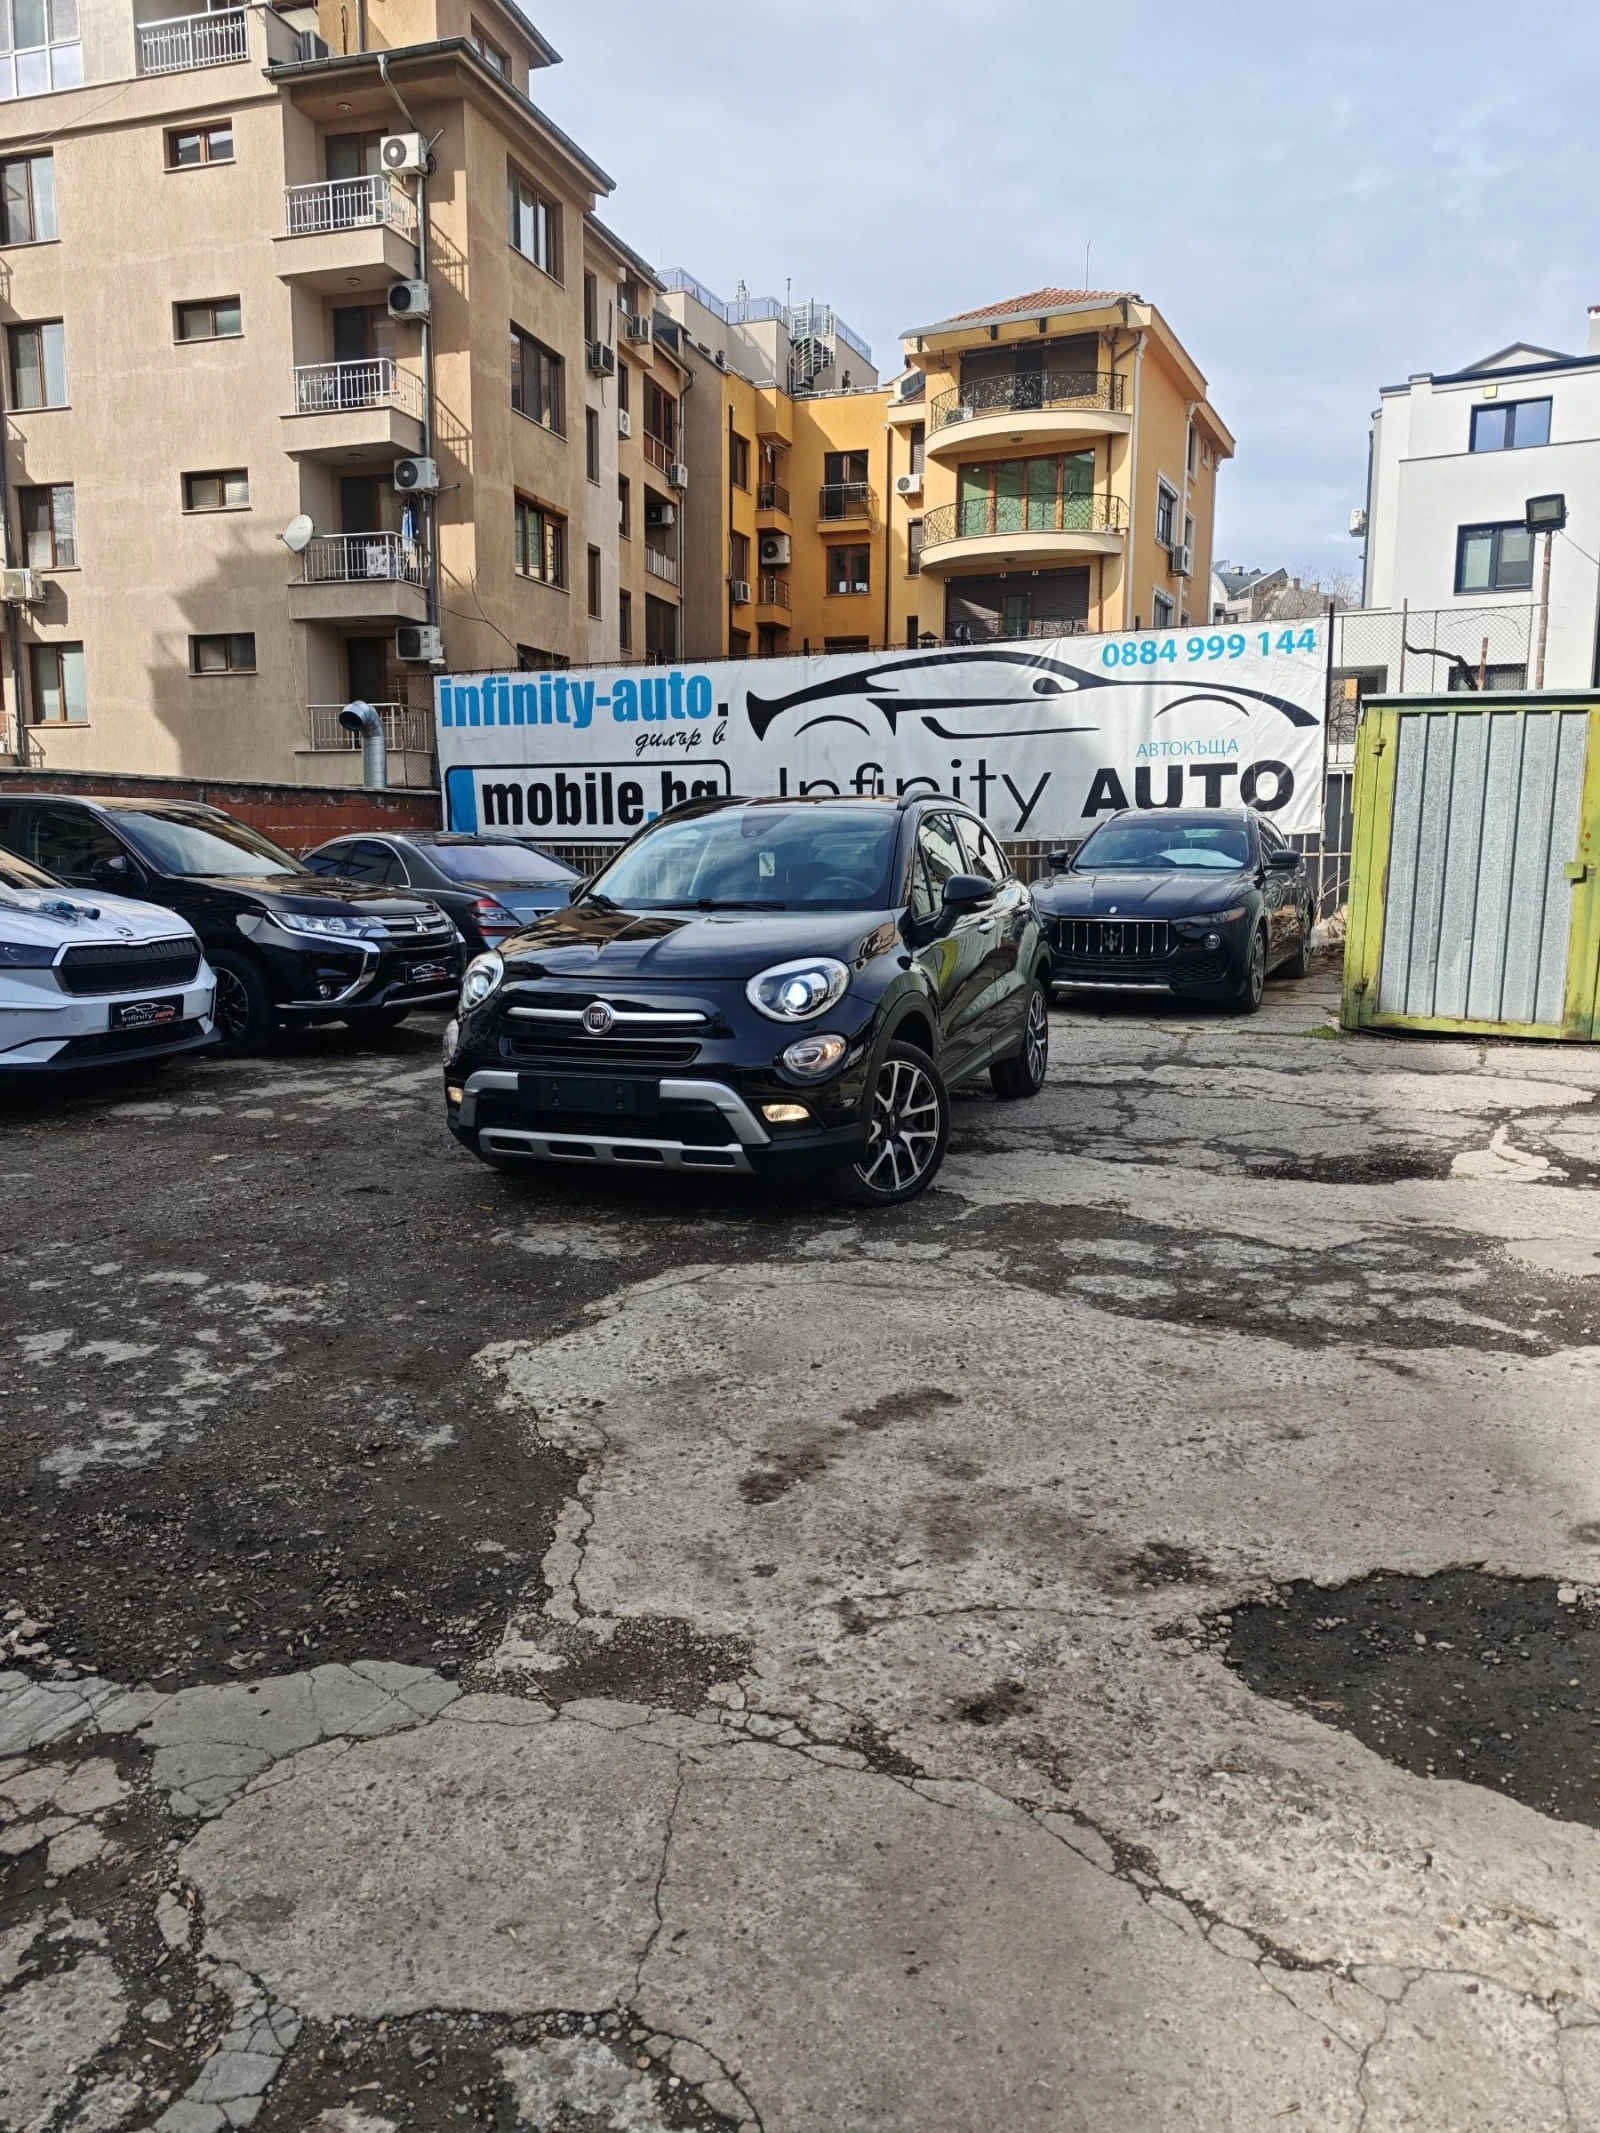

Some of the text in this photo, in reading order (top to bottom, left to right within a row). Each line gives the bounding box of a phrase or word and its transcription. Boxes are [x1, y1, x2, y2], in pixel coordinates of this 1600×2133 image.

[1102, 628, 1317, 668] 0884 999 144
[635, 719, 727, 757] дилър в
[1136, 738, 1239, 758] АВТОКЪЩА
[1080, 759, 1295, 818] AUTO
[121, 1012, 154, 1023] Infinity
[590, 1012, 606, 1026] FIAT
